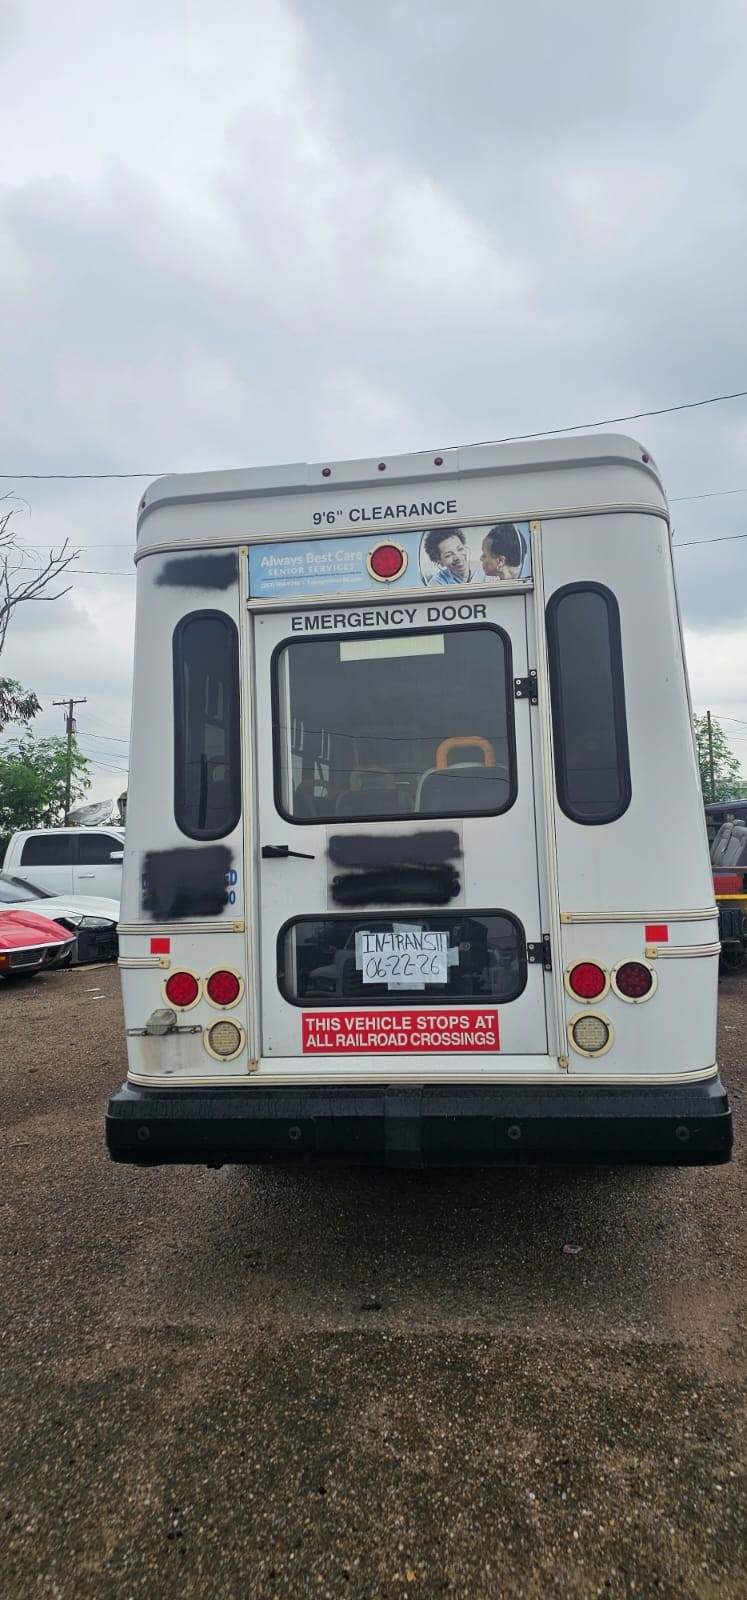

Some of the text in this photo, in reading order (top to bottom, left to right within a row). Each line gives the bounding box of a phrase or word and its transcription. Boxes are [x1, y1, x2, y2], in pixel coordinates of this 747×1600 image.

[313, 500, 458, 525] 9'6" CLEARANCE
[260, 549, 363, 568] Always Best Care
[268, 563, 354, 576] SENIOR SERVICES
[291, 604, 487, 632] EMERGENCY DOOR
[363, 933, 449, 953] IN-TRANSIT
[366, 954, 440, 978] 06-22-26
[306, 1015, 495, 1031] THIS VEHICLE STOPS AT
[306, 1032, 496, 1047] ALL RAILROAD CROSSINGS
